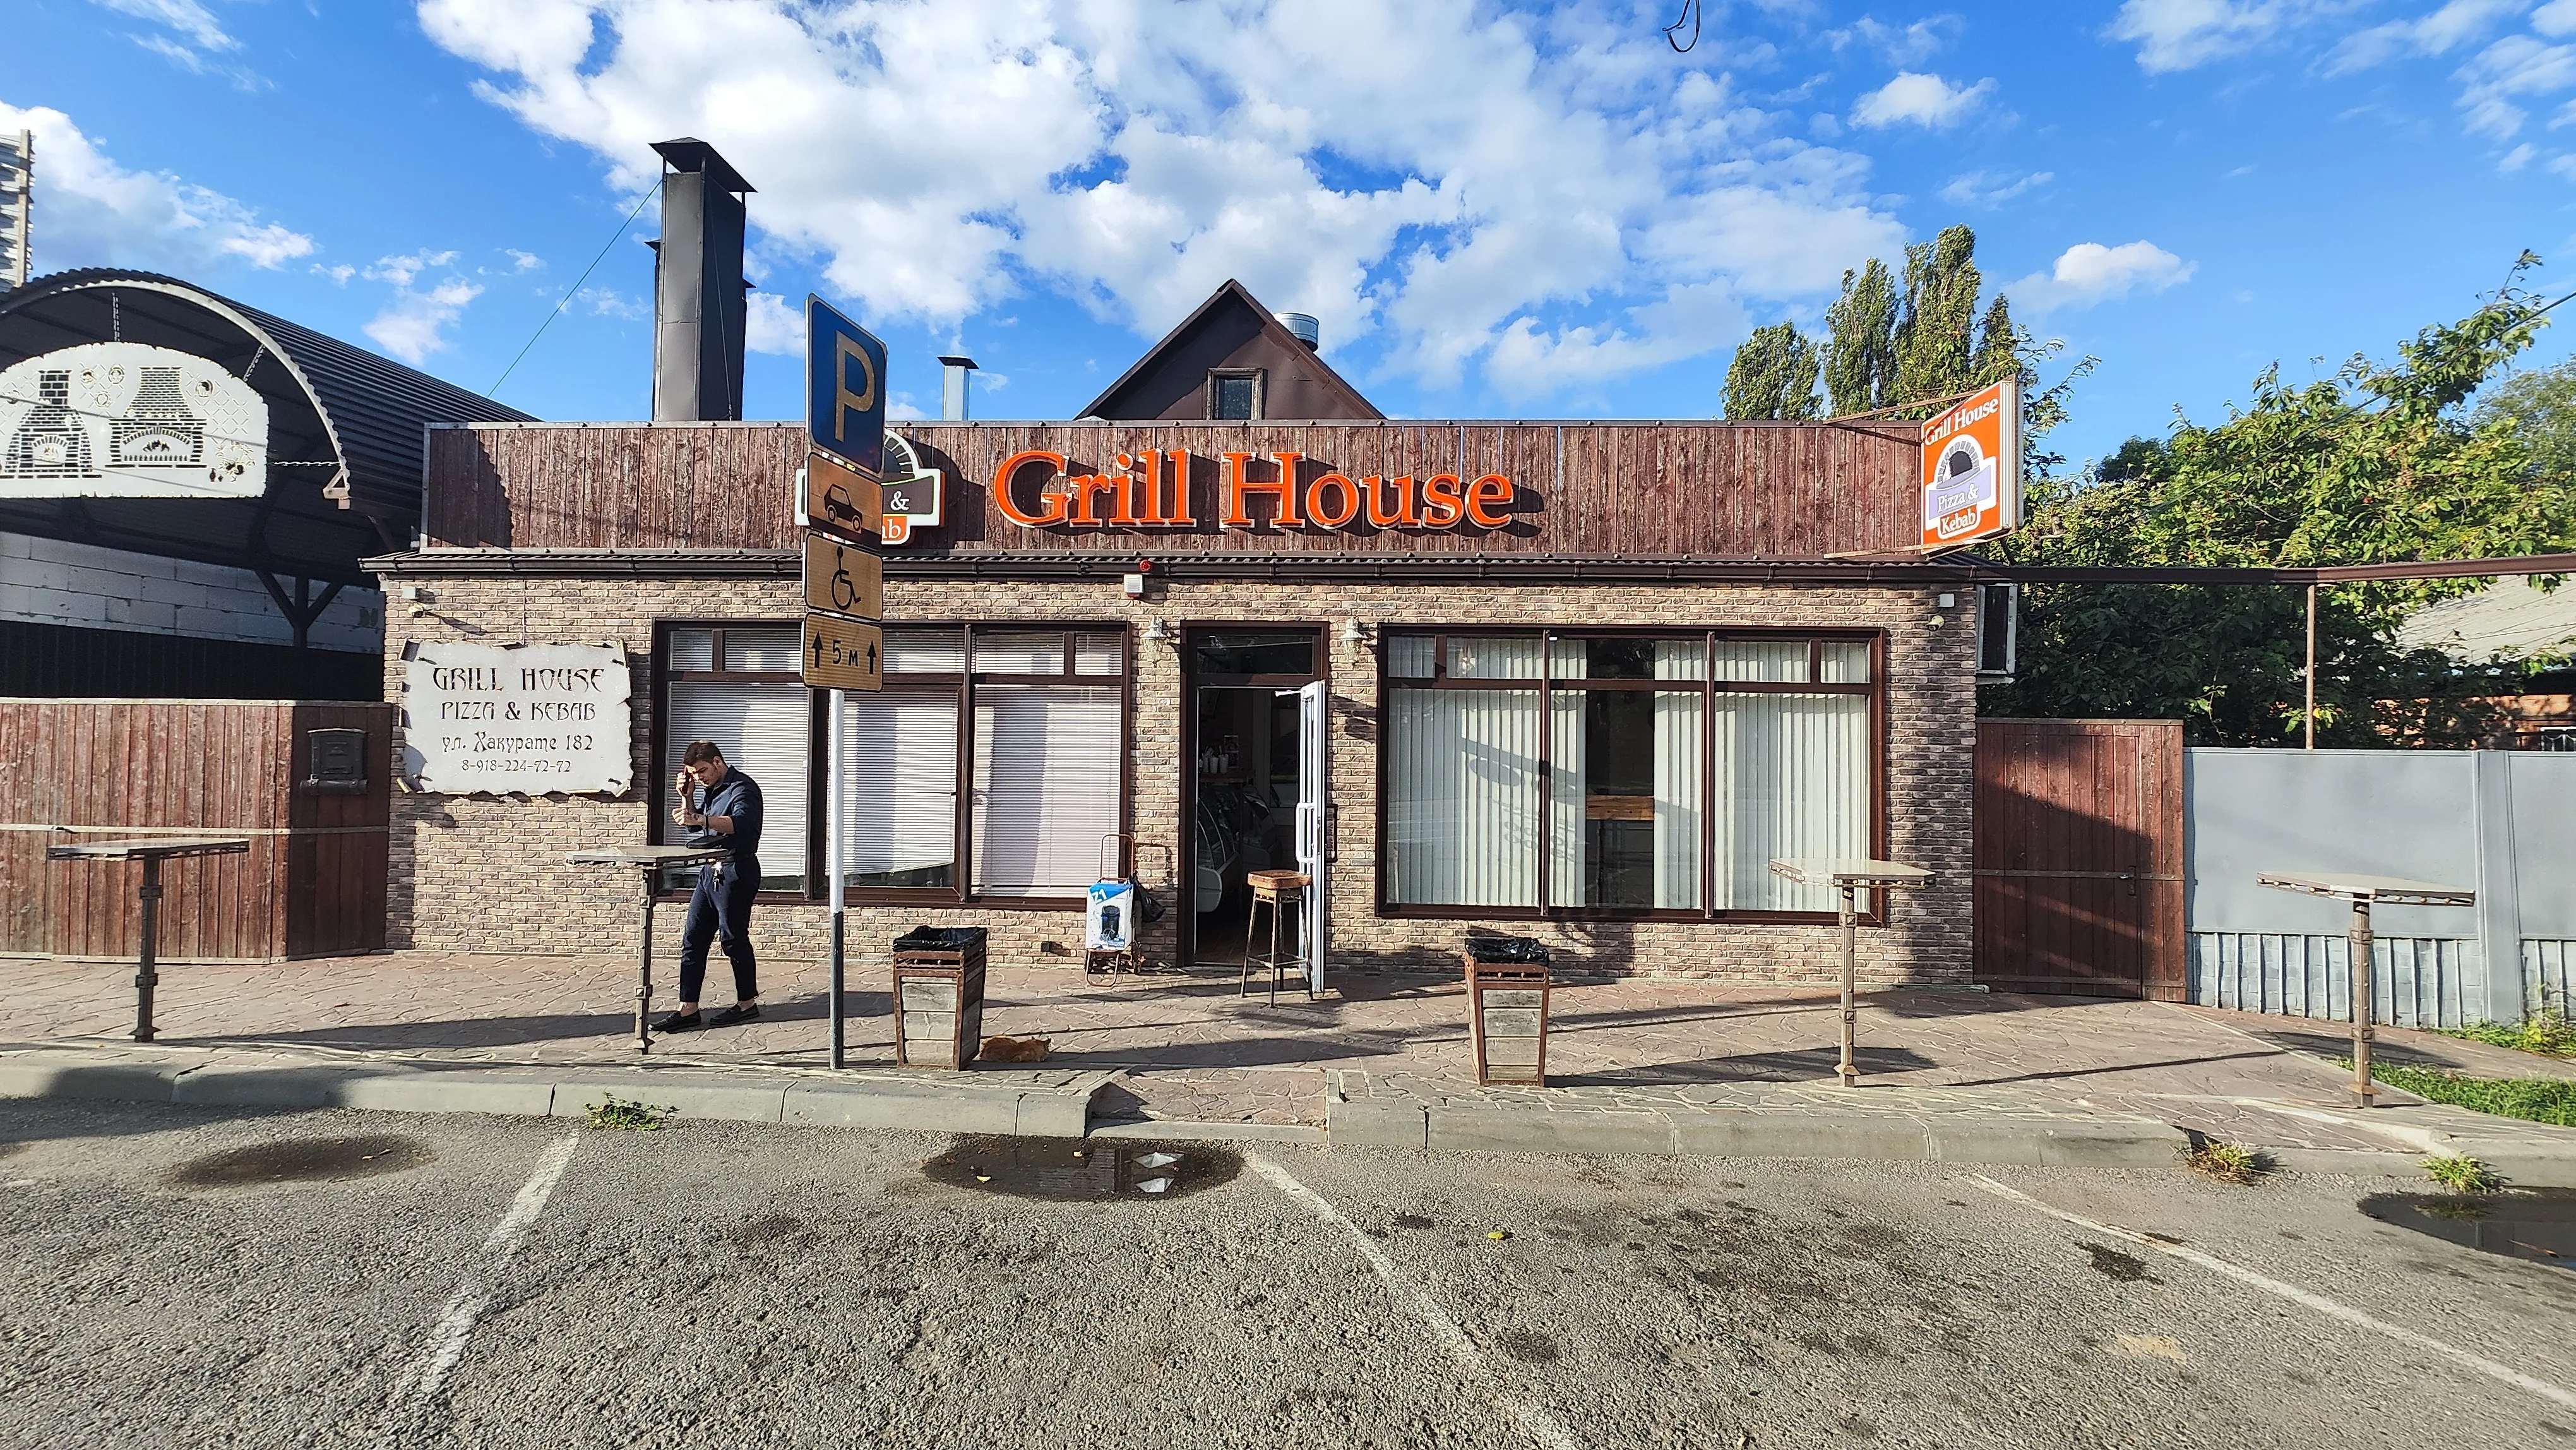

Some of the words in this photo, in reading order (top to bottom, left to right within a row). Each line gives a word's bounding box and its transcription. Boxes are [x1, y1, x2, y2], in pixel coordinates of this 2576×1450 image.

[835, 330, 875, 442] P
[1926, 416, 1952, 446] Grill
[1953, 398, 1998, 431] House
[890, 491, 910, 510] &
[994, 448, 1196, 528] Grill
[1219, 452, 1514, 530] House
[1937, 493, 1965, 513] Pizza
[1967, 483, 1979, 500] &
[1940, 508, 1976, 535] Kebab
[832, 640, 842, 664] 5
[433, 668, 504, 691] GRILL
[522, 668, 605, 692] HOUSE
[441, 702, 494, 721] PIZZA
[505, 701, 521, 721] &
[531, 702, 596, 721] KEBAB
[442, 736, 467, 752] ул.
[473, 731, 558, 753] Хакурате
[566, 734, 593, 750] 182
[462, 759, 571, 773] 8-918-224-72-72
